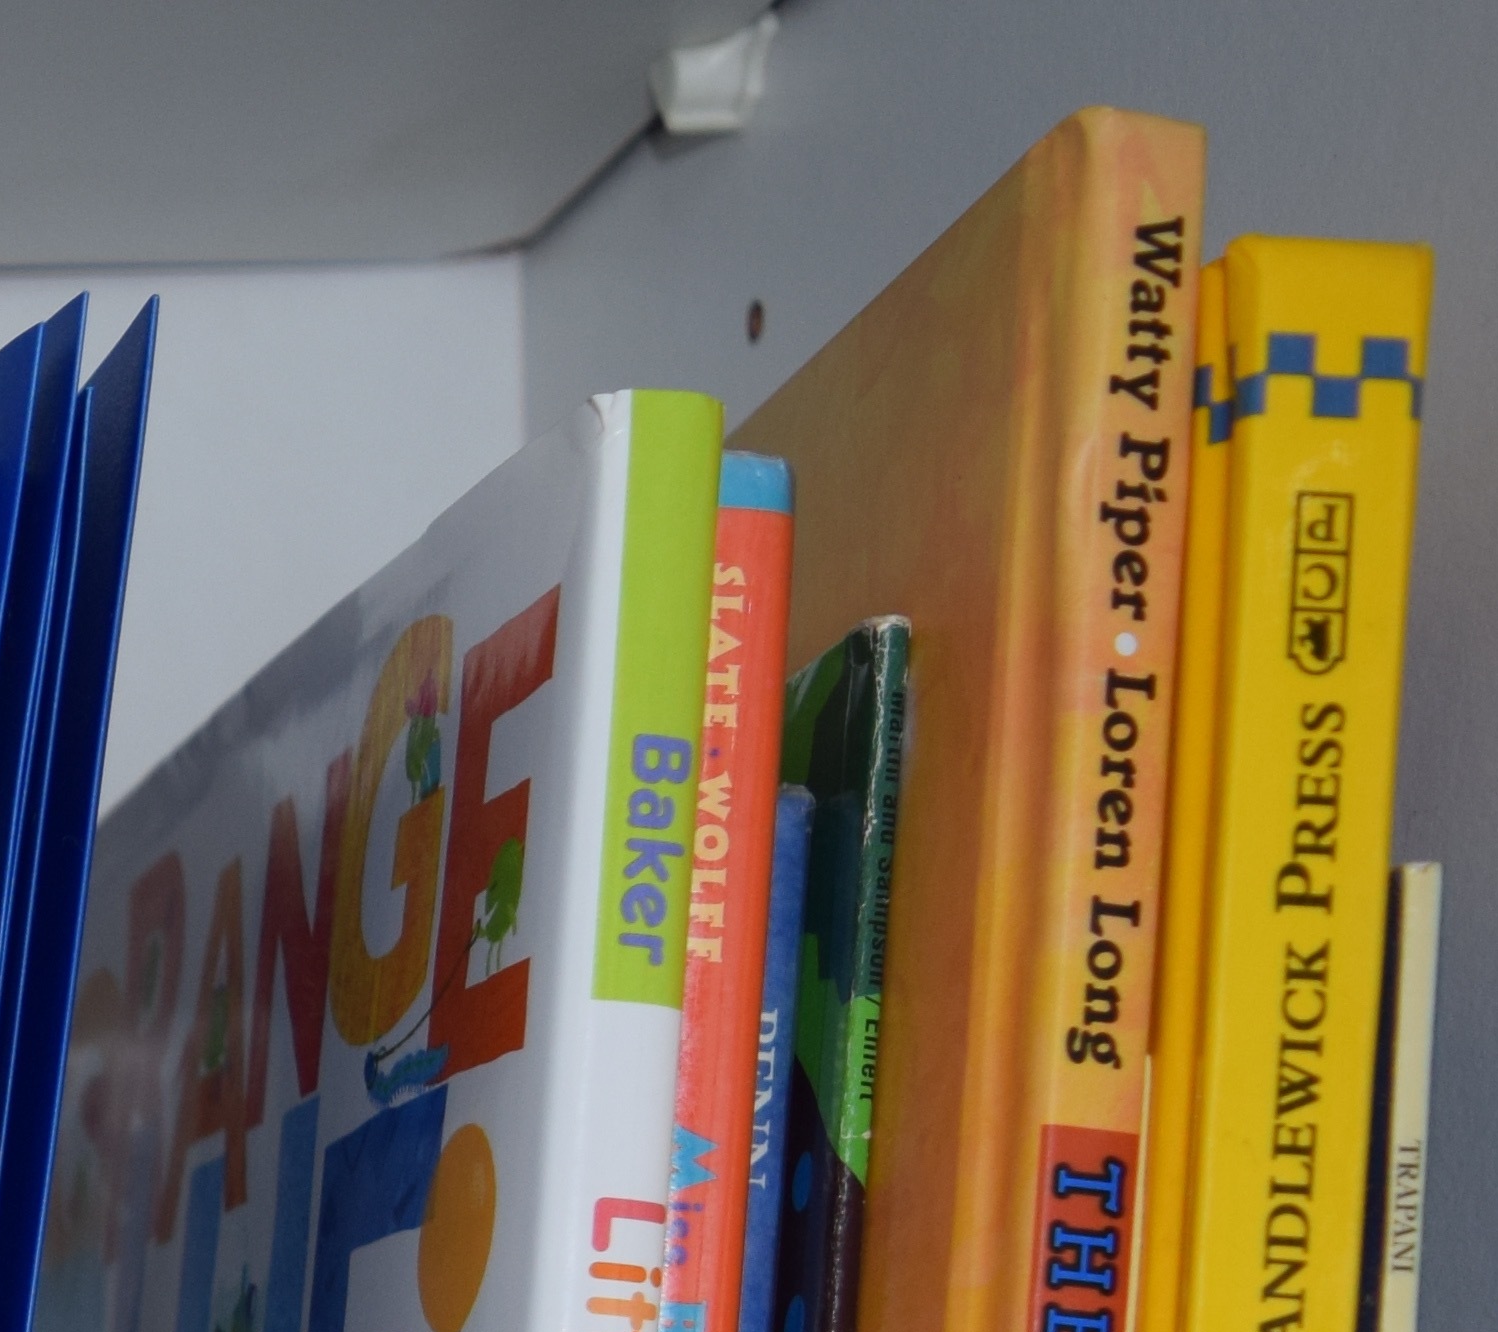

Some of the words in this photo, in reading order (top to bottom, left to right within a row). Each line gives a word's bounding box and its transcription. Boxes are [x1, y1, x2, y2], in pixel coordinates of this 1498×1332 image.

[1110, 216, 1184, 412] Watty
[1100, 431, 1171, 622] Piper
[704, 561, 746, 731] SLATE
[617, 731, 692, 967] Baker
[1092, 667, 1156, 868] Loren
[1274, 702, 1347, 913] PRESS
[685, 770, 734, 965] WOLFF
[1067, 900, 1140, 1069] Long
[1390, 1138, 1423, 1275] TRAPANI
